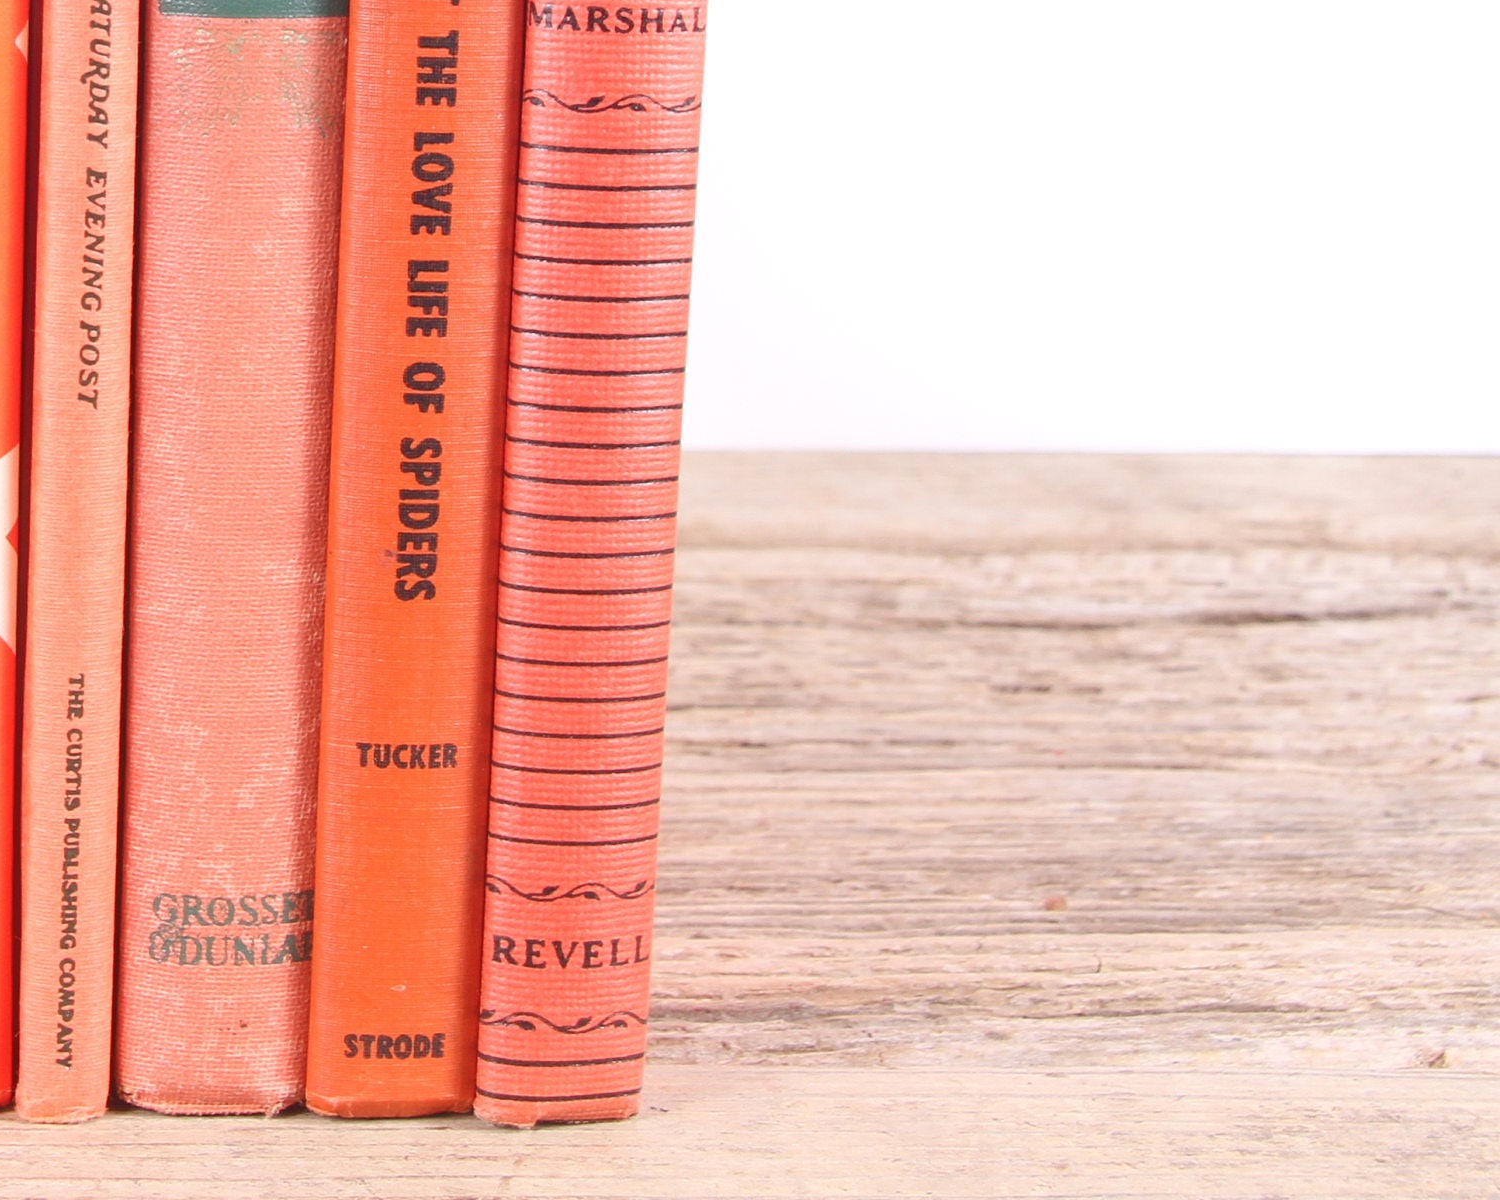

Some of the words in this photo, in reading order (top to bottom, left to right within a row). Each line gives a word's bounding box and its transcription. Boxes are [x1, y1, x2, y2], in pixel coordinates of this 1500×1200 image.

[415, 29, 460, 108] THE
[409, 131, 455, 236] LOVE
[80, 167, 108, 312] EVENING
[405, 259, 450, 338] LIFE
[76, 321, 101, 409] POST
[402, 361, 446, 414] OF
[394, 437, 443, 602] SPIDERS
[67, 673, 85, 720] THE
[64, 728, 83, 811] CURTIS
[356, 742, 458, 769] TUCKER
[59, 818, 81, 950] PUBLISHING
[492, 935, 649, 969] REVELL
[56, 957, 76, 1069] COMPANY
[343, 1032, 446, 1060] STRODE
